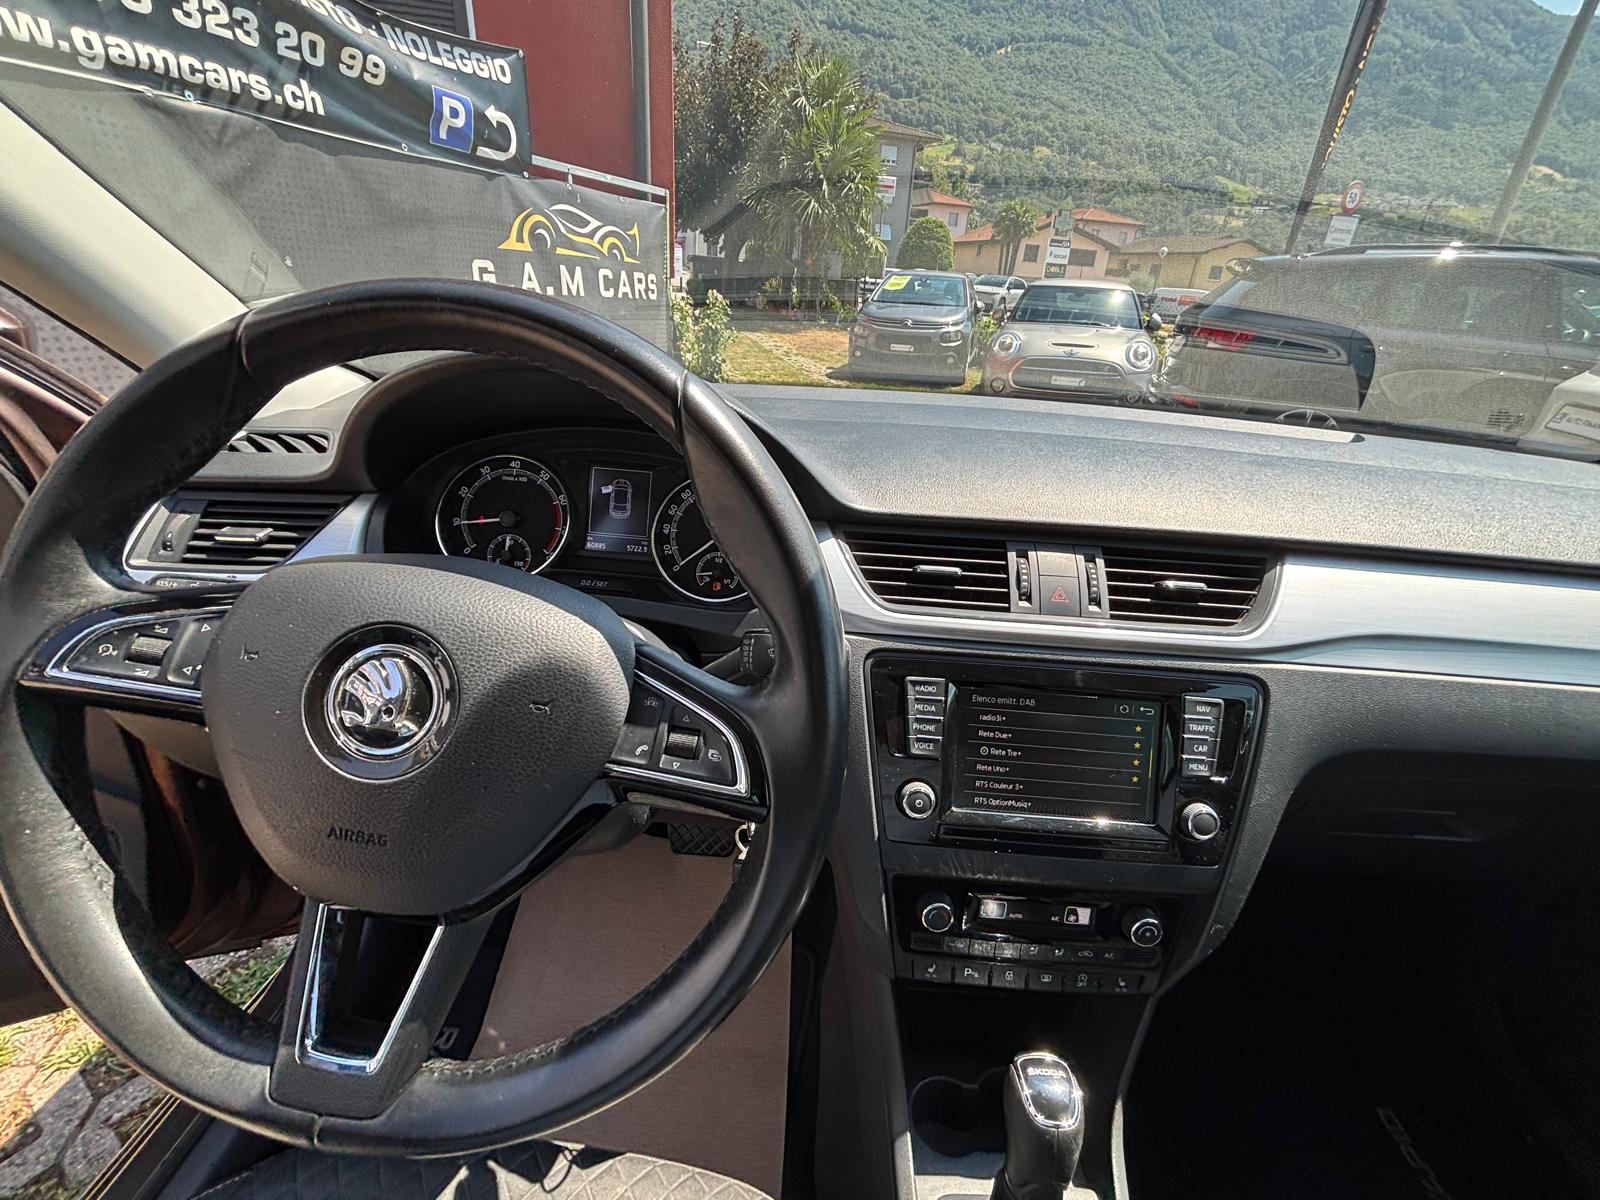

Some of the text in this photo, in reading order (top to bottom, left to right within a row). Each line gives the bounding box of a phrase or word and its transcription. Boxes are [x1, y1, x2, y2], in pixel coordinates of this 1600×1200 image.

[171, 0, 386, 86] 323 20 99
[380, 21, 512, 85] NOLEGGIO
[439, 96, 466, 140] P
[598, 268, 658, 301] CARS
[509, 460, 521, 469] 40
[479, 465, 491, 476] 30
[538, 470, 550, 481] 50
[458, 486, 469, 498] 20
[680, 489, 692, 500] 80
[668, 504, 678, 515] 60
[662, 523, 671, 534] 40
[663, 544, 672, 555] 20
[915, 685, 937, 693] RADIO
[972, 694, 1036, 707] Elenco emitt. DAB
[914, 703, 936, 712] MEDIA
[1196, 705, 1211, 713] NAV
[912, 722, 936, 731] PHONE
[1188, 723, 1216, 733] TRAFFIC
[978, 729, 995, 738] Rete
[914, 741, 935, 750] VOICE
[1193, 744, 1208, 753] CAR
[990, 747, 1007, 756] Rete
[976, 763, 993, 772] Rete
[1188, 763, 1209, 771] MENU
[975, 780, 988, 788] RTS
[989, 781, 1014, 790] Couleur
[974, 797, 988, 805] RTS
[327, 826, 388, 847] AIRBAG
